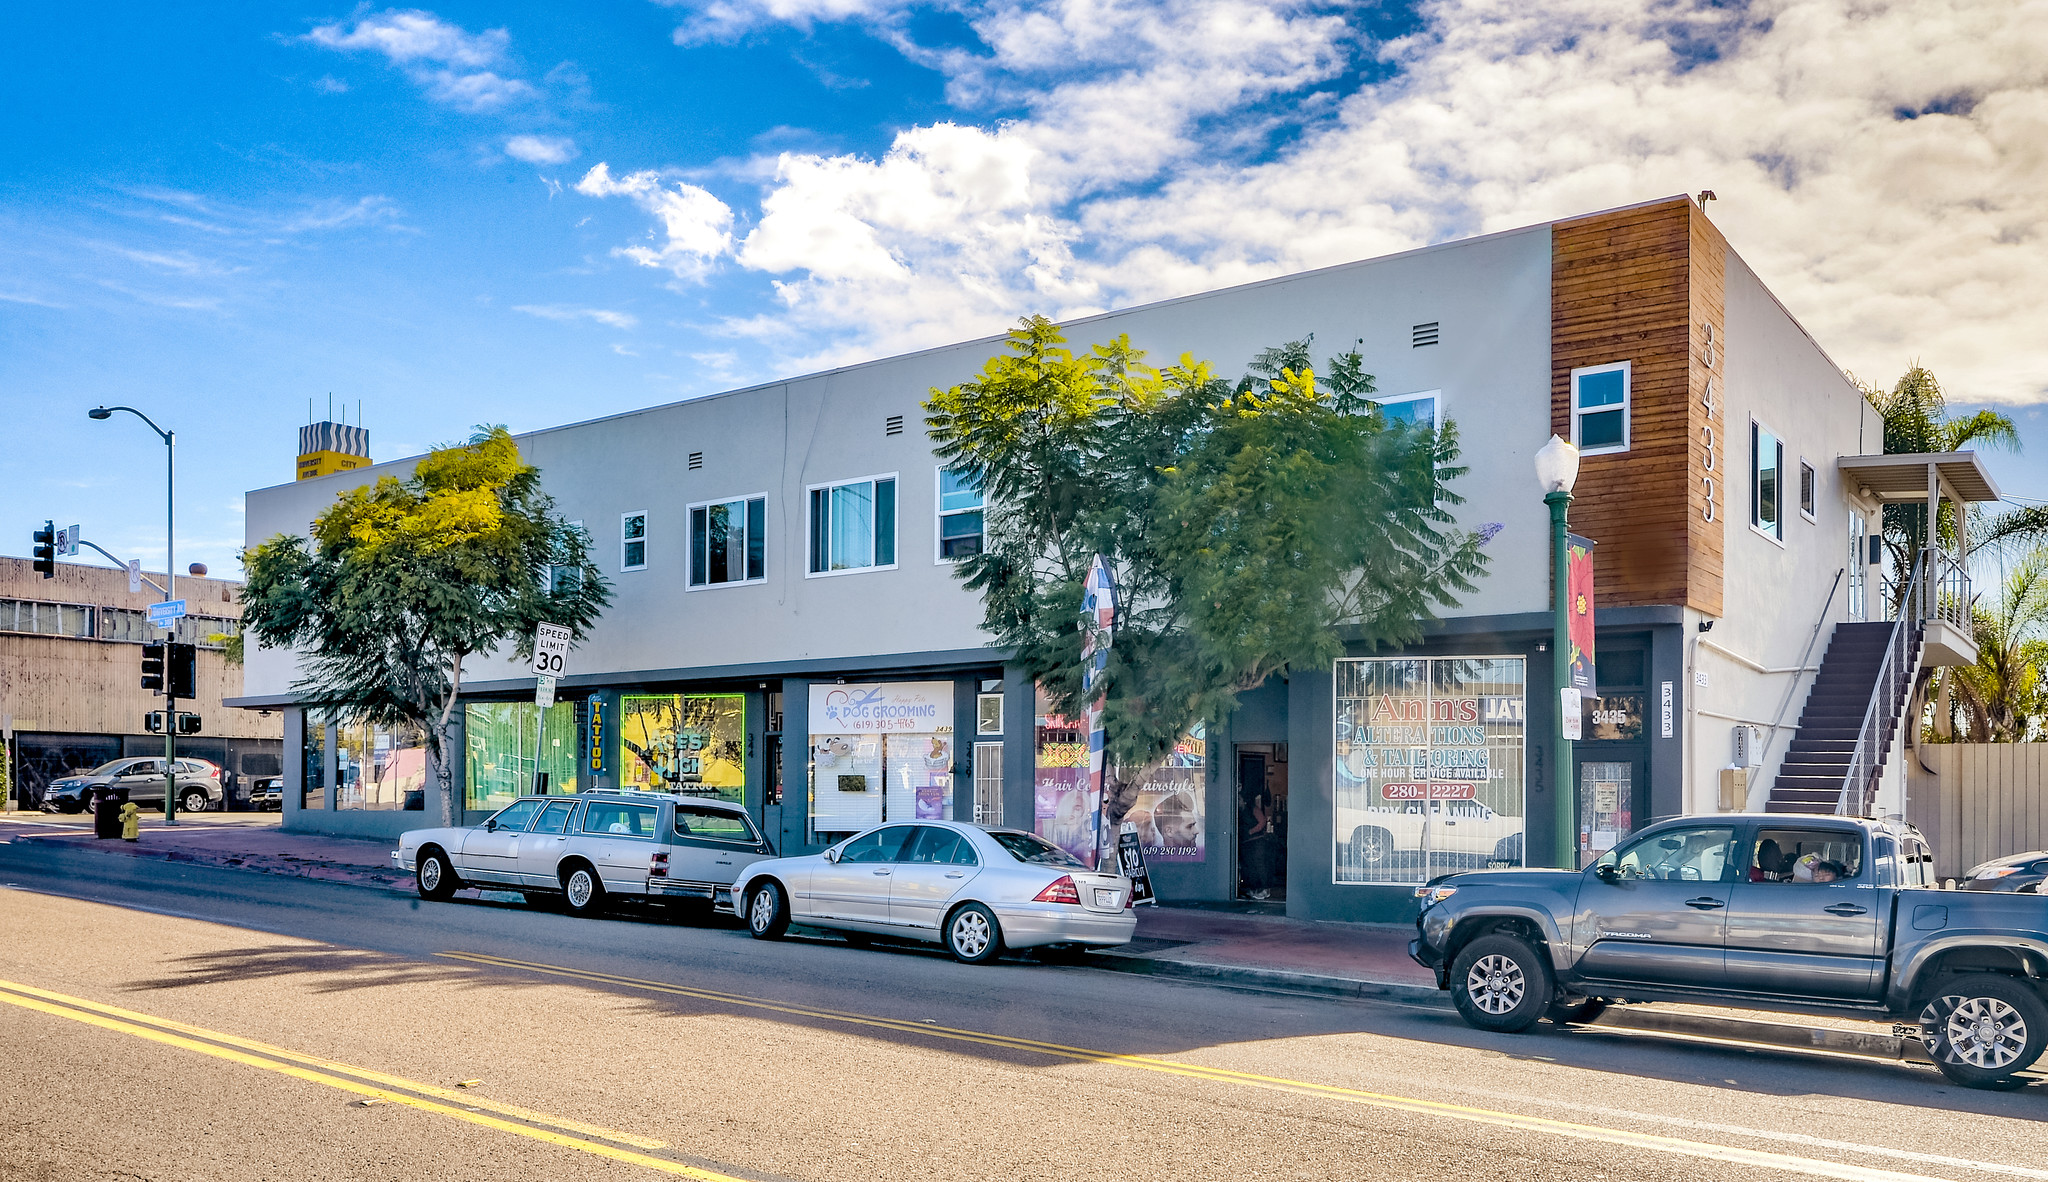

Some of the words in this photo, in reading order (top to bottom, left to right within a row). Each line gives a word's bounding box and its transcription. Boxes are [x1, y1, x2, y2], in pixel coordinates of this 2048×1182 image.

[1702, 323, 1715, 523] 3433
[341, 459, 358, 469] CITY
[539, 627, 569, 641] SPEED
[540, 640, 565, 652] LIMIT
[536, 651, 563, 673] 30
[843, 705, 869, 719] DOG
[872, 704, 936, 719] GROOMING
[1371, 693, 1479, 723] Ann's
[1663, 687, 1672, 732] 3433
[1592, 709, 1627, 725] 3435
[853, 720, 874, 730] (619)
[591, 702, 603, 770] TATTOO
[1353, 725, 1486, 746] ALTERATIONS
[1363, 749, 1378, 768] &
[1381, 748, 1490, 768] TAILORING
[1360, 769, 1378, 779] ONE
[1380, 769, 1406, 779] HOUR
[1408, 768, 1453, 779] SERVICE
[1454, 768, 1505, 779] AVAILABLE
[670, 781, 713, 791] TATTOO
[1042, 777, 1073, 792] Hair
[1140, 778, 1195, 795] airstyle
[1143, 846, 1158, 856] 619
[1160, 846, 1176, 856] 280
[1178, 845, 1197, 856] 1192
[1124, 847, 1140, 871] $10
[1488, 861, 1511, 870] SORRY
[1602, 930, 1653, 940] TACOMA
